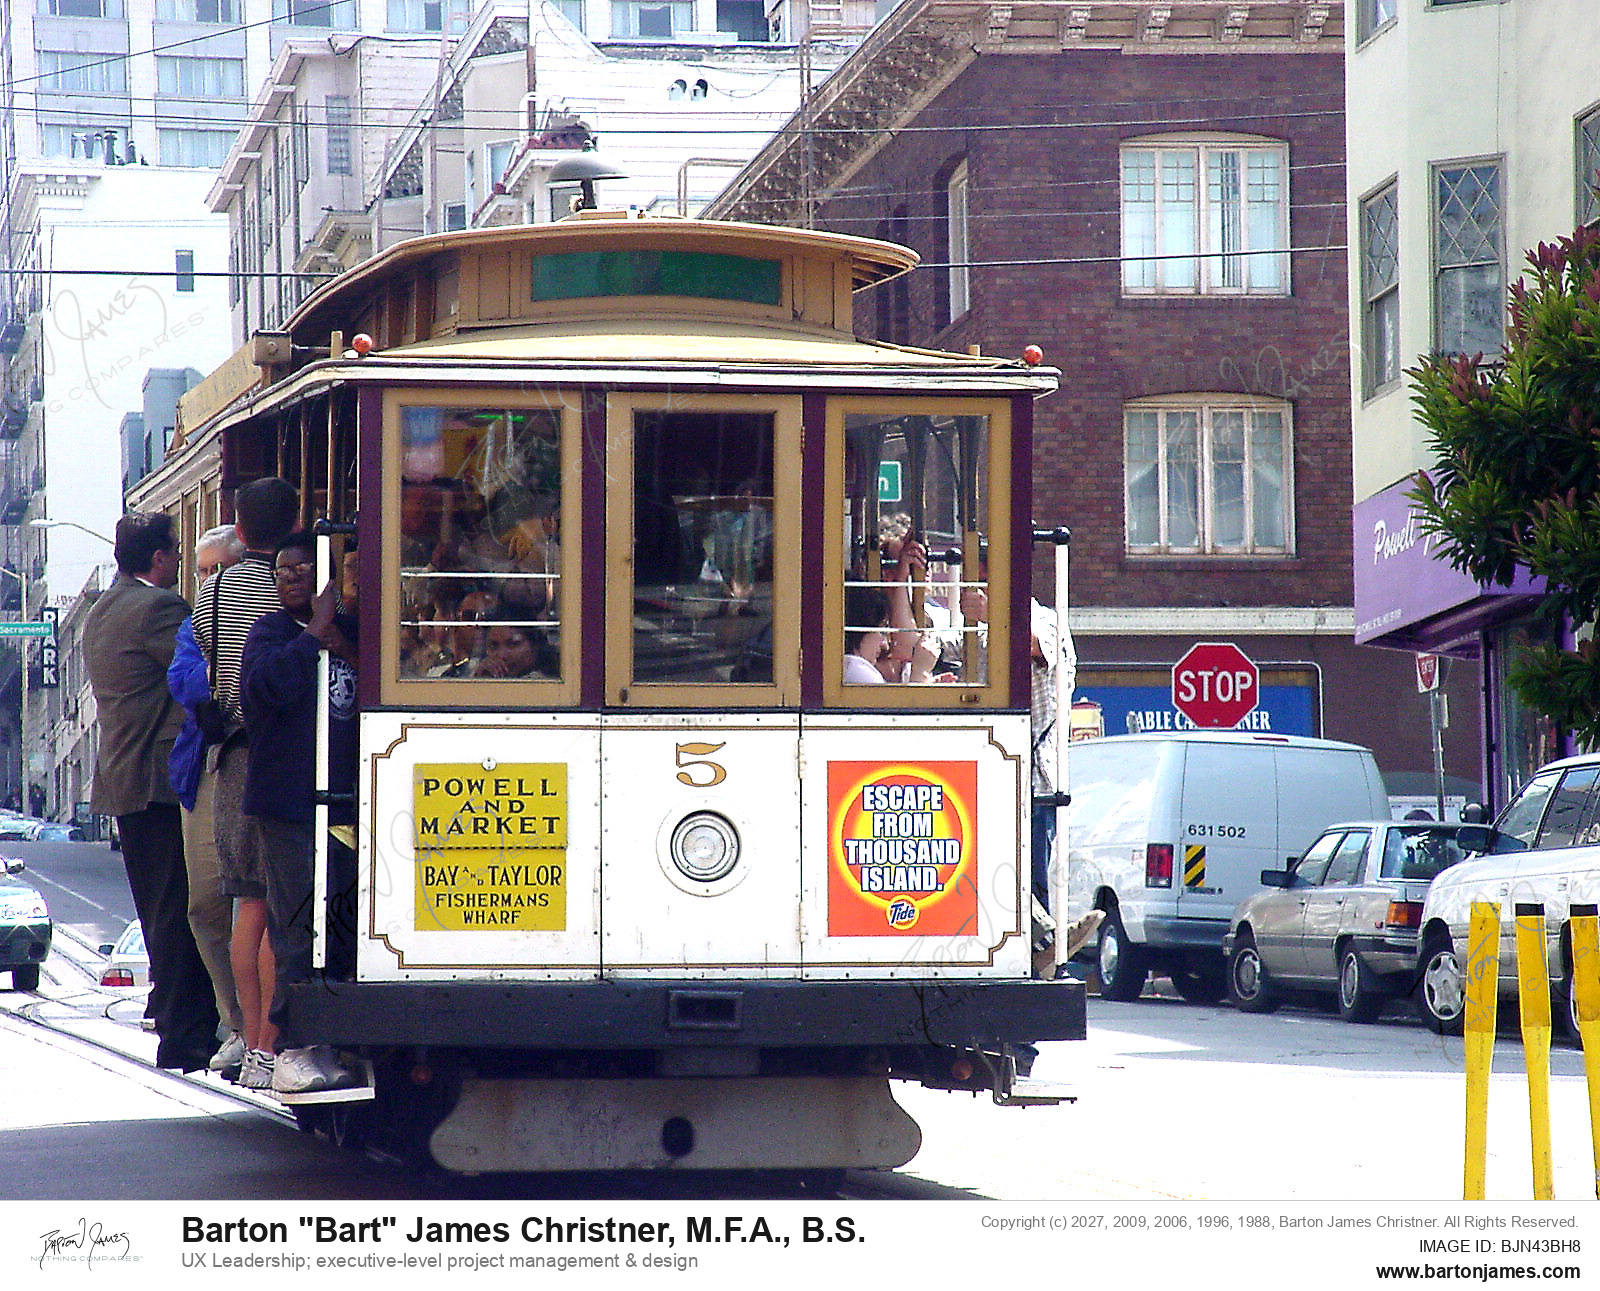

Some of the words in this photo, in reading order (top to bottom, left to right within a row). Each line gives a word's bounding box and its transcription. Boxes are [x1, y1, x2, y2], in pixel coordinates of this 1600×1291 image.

[1374, 508, 1416, 565] Powell
[43, 611, 57, 685] PARK
[1178, 670, 1253, 702] STOP
[676, 741, 727, 787] 5
[423, 779, 557, 796] POWELL
[863, 785, 943, 811] ESCAPE
[460, 800, 525, 813] AND
[420, 817, 561, 834] MARKET
[873, 812, 933, 838] FROM
[1188, 824, 1247, 839] 631502
[844, 839, 961, 865] THOUSAND
[425, 865, 458, 886] BAY
[462, 866, 484, 886] AND
[488, 865, 562, 886] TAYLOR
[861, 866, 945, 892] ISLAND.
[436, 893, 549, 908] FISHERMANS
[463, 910, 521, 925] WHARF
[889, 902, 916, 925] Tide
